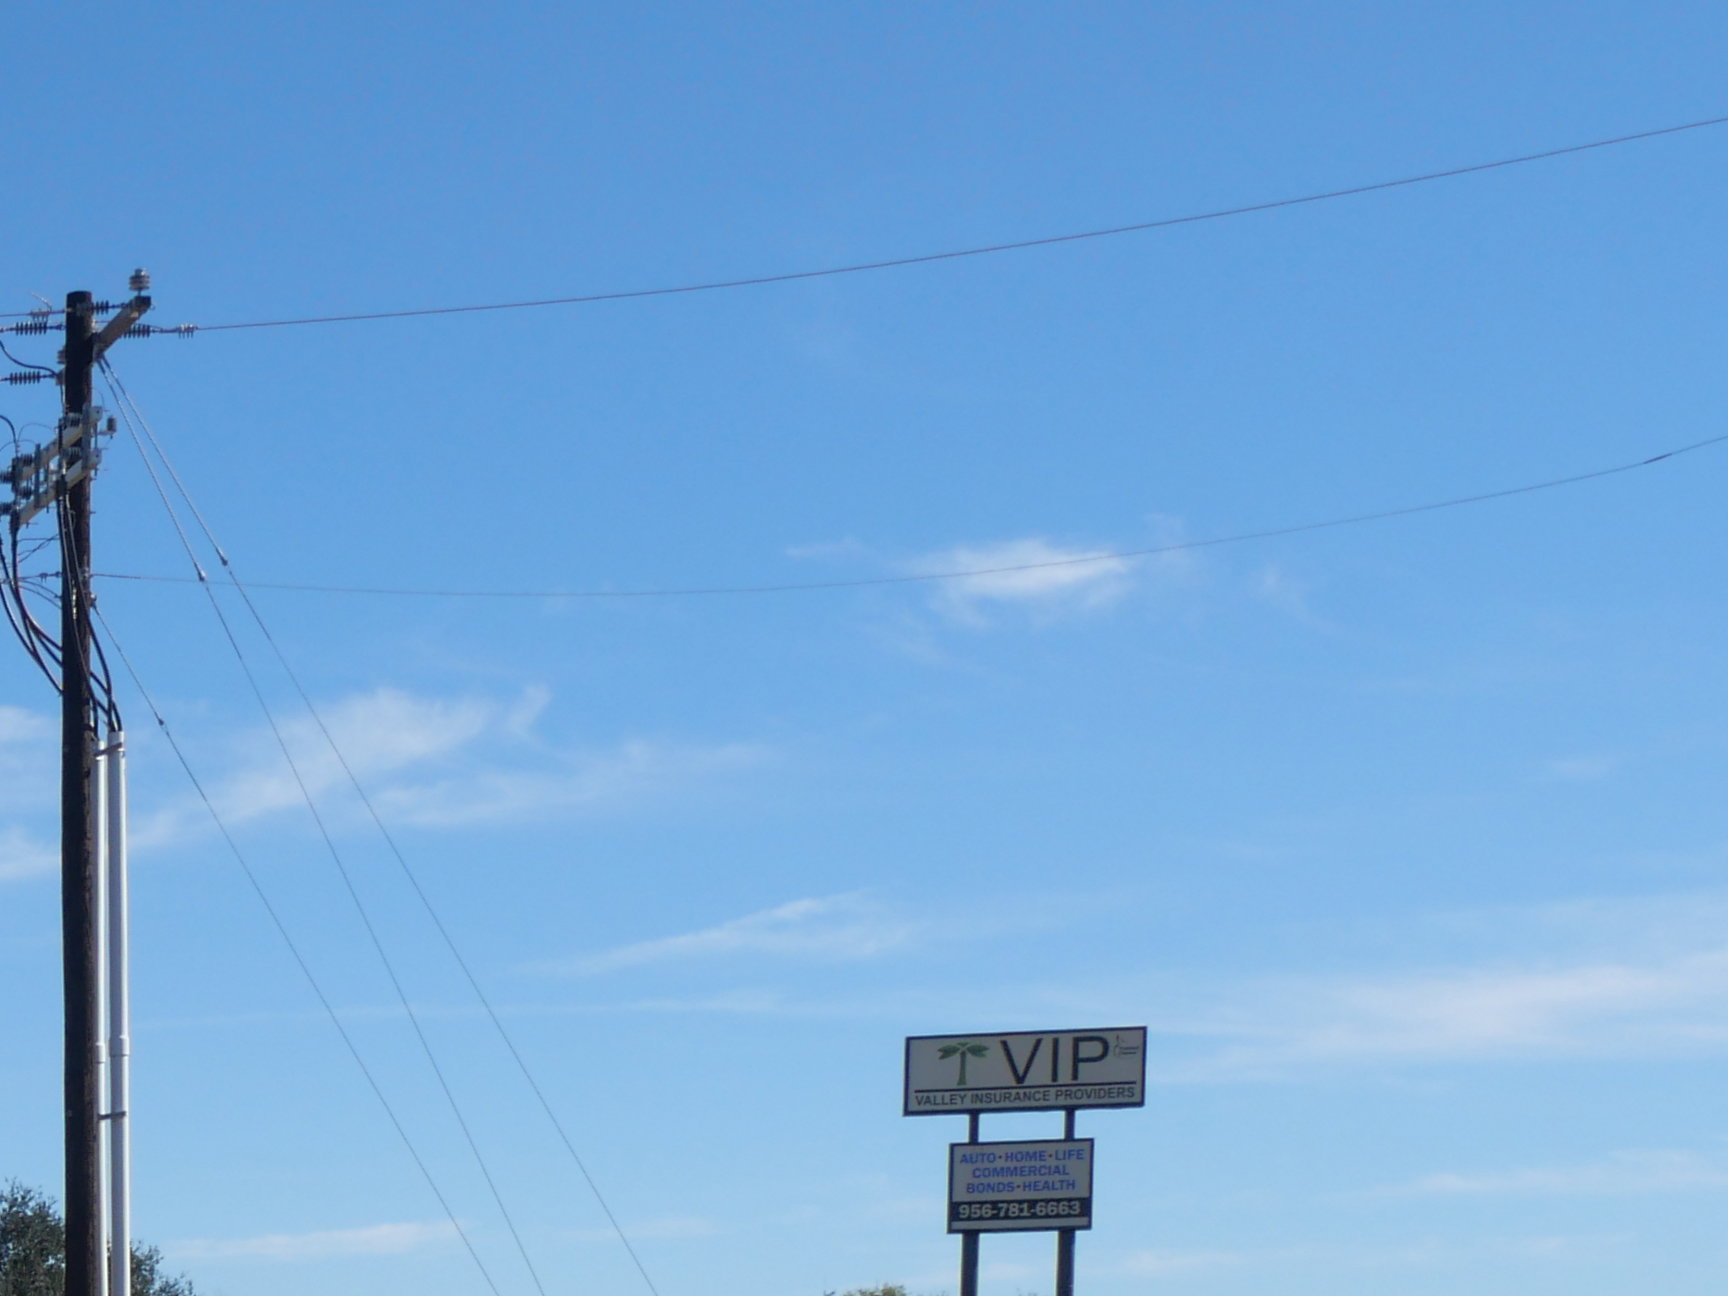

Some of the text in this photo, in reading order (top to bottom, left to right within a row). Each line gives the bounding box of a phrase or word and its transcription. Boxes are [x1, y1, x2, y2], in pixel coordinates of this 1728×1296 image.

[1000, 1036, 1109, 1084] VIP
[915, 1086, 1136, 1106] VALLEY INSURANCE PROVIDERS
[960, 1148, 1085, 1164] AUTO HOME LIFE
[972, 1165, 1070, 1178] COMMERCIAL
[966, 1179, 1076, 1194] BONDS HEALTH
[959, 1201, 1081, 1218] 956-781-6663
